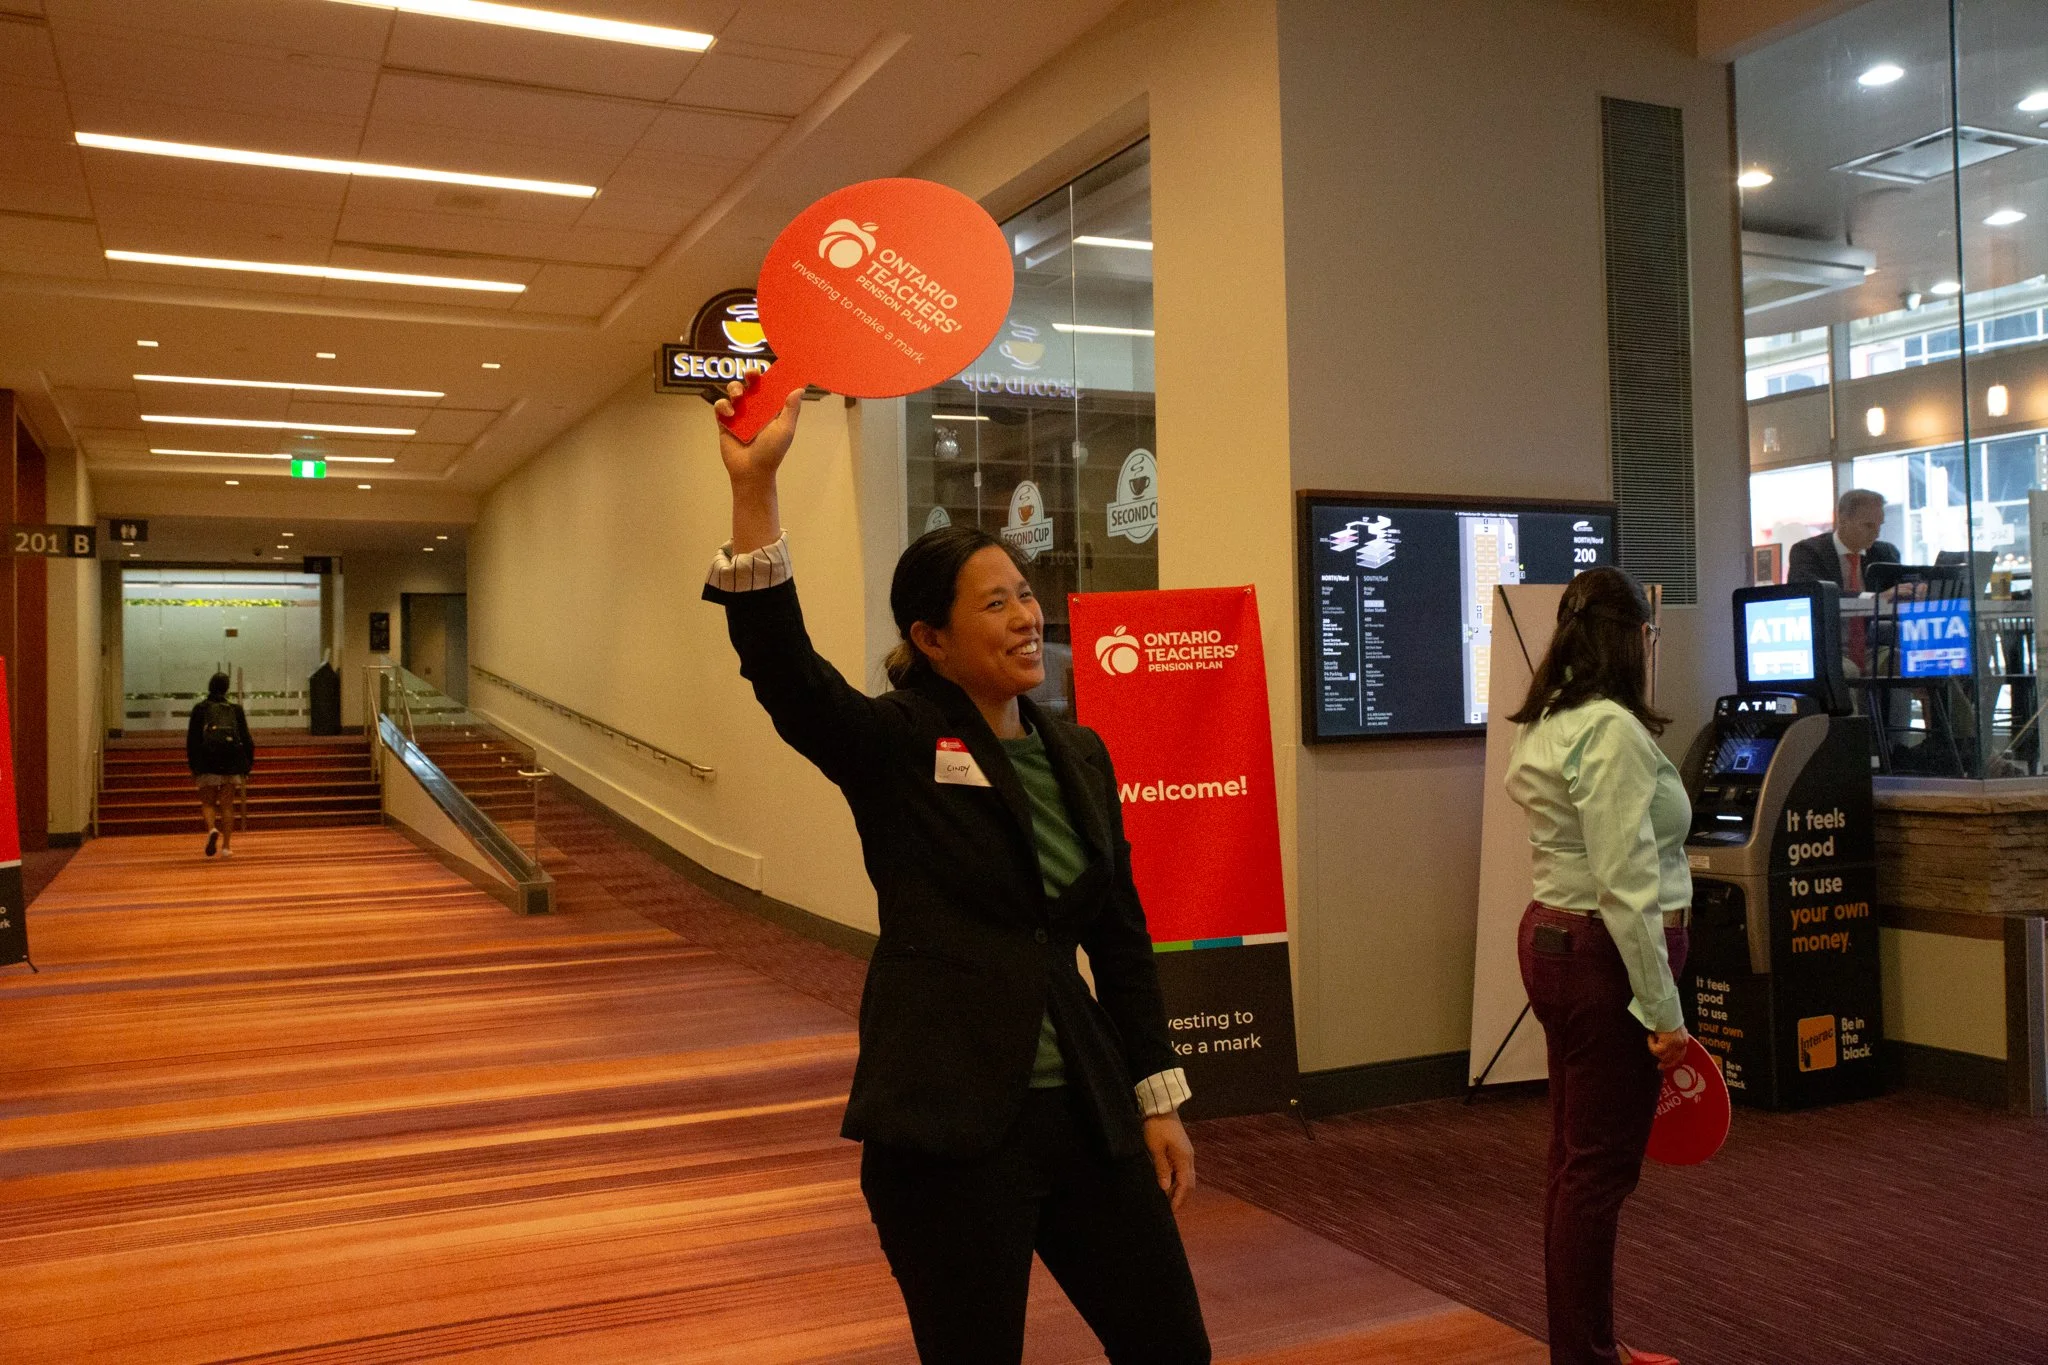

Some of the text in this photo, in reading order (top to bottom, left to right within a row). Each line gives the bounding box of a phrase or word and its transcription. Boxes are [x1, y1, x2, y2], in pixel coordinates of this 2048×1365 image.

[879, 248, 958, 310] ONTARIO
[855, 274, 932, 334] PENSION PLAN
[866, 260, 963, 334] TEACHERS'
[792, 259, 926, 364] Investing to make a mark
[1111, 506, 1148, 527] SECOND
[15, 532, 90, 554] 201 B
[1034, 526, 1050, 544] CUP
[1573, 548, 1597, 563] 200
[1143, 630, 1222, 647] ONTARIO
[1750, 616, 1810, 645] ATM
[1145, 644, 1239, 663] TEACHERS'
[1148, 661, 1223, 672] PENSION PLAN
[1737, 700, 1777, 712] ATM
[947, 764, 970, 777] CINDY
[1118, 775, 1248, 803] Welcome!
[1786, 807, 1846, 833] It feels
[1787, 835, 1835, 866] good
[1789, 876, 1843, 897] to use
[1790, 901, 1869, 931] your own
[1695, 975, 1731, 993] It feels
[1697, 992, 1724, 1006] good
[1234, 1010, 1254, 1025] to
[1697, 1006, 1729, 1021] to use
[1698, 1022, 1744, 1039] your own
[1841, 1016, 1865, 1032] Be in
[1198, 1041, 1208, 1054] a
[1213, 1033, 1262, 1052] mark
[1841, 1031, 1859, 1046] the
